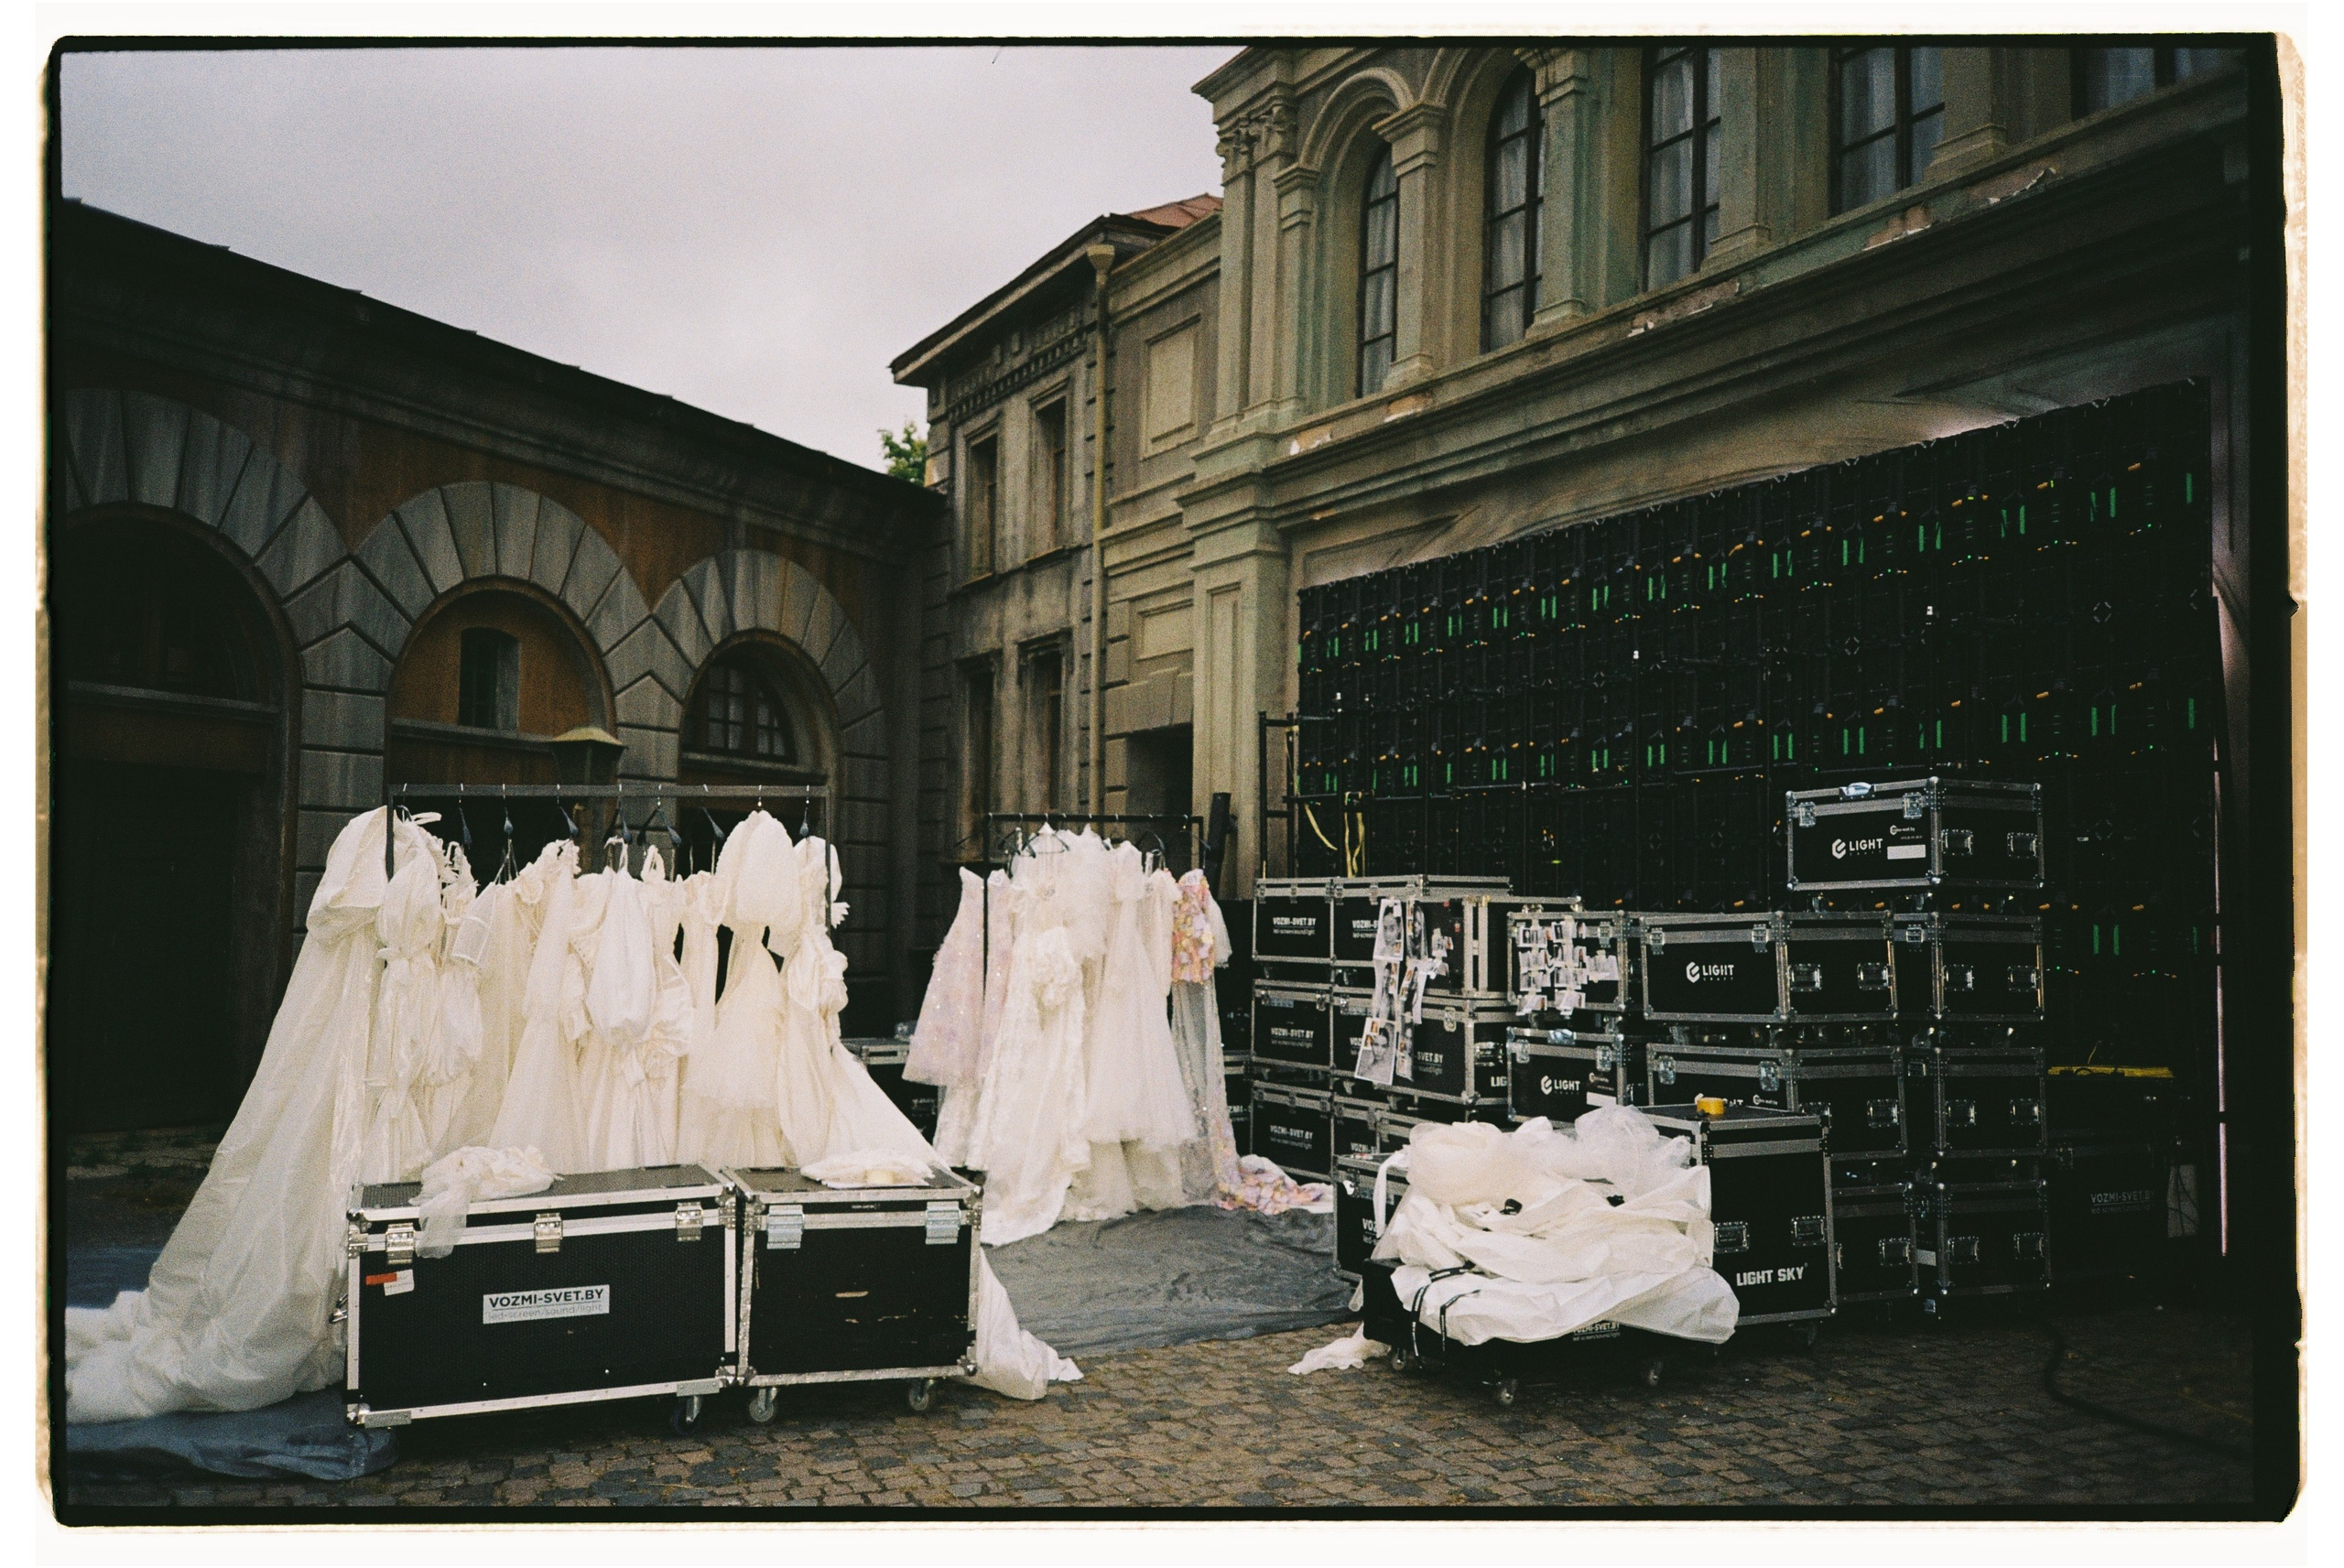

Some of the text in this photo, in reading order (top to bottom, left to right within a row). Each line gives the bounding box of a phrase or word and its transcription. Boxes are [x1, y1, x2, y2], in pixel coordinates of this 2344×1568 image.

[1850, 838, 1883, 851] LIGHT
[1273, 917, 1316, 926] VOZMI-SVET.BY
[1351, 920, 1378, 928] VOZMI-S
[1702, 964, 1734, 976] LIGHT
[1414, 1052, 1444, 1063] -SVET.BY
[1490, 1076, 1508, 1087] LIG
[1554, 1079, 1581, 1091] LIGHT
[1736, 1266, 1804, 1286] LIGHT SKY
[489, 1288, 604, 1308] VOZMI-SVET.BY
